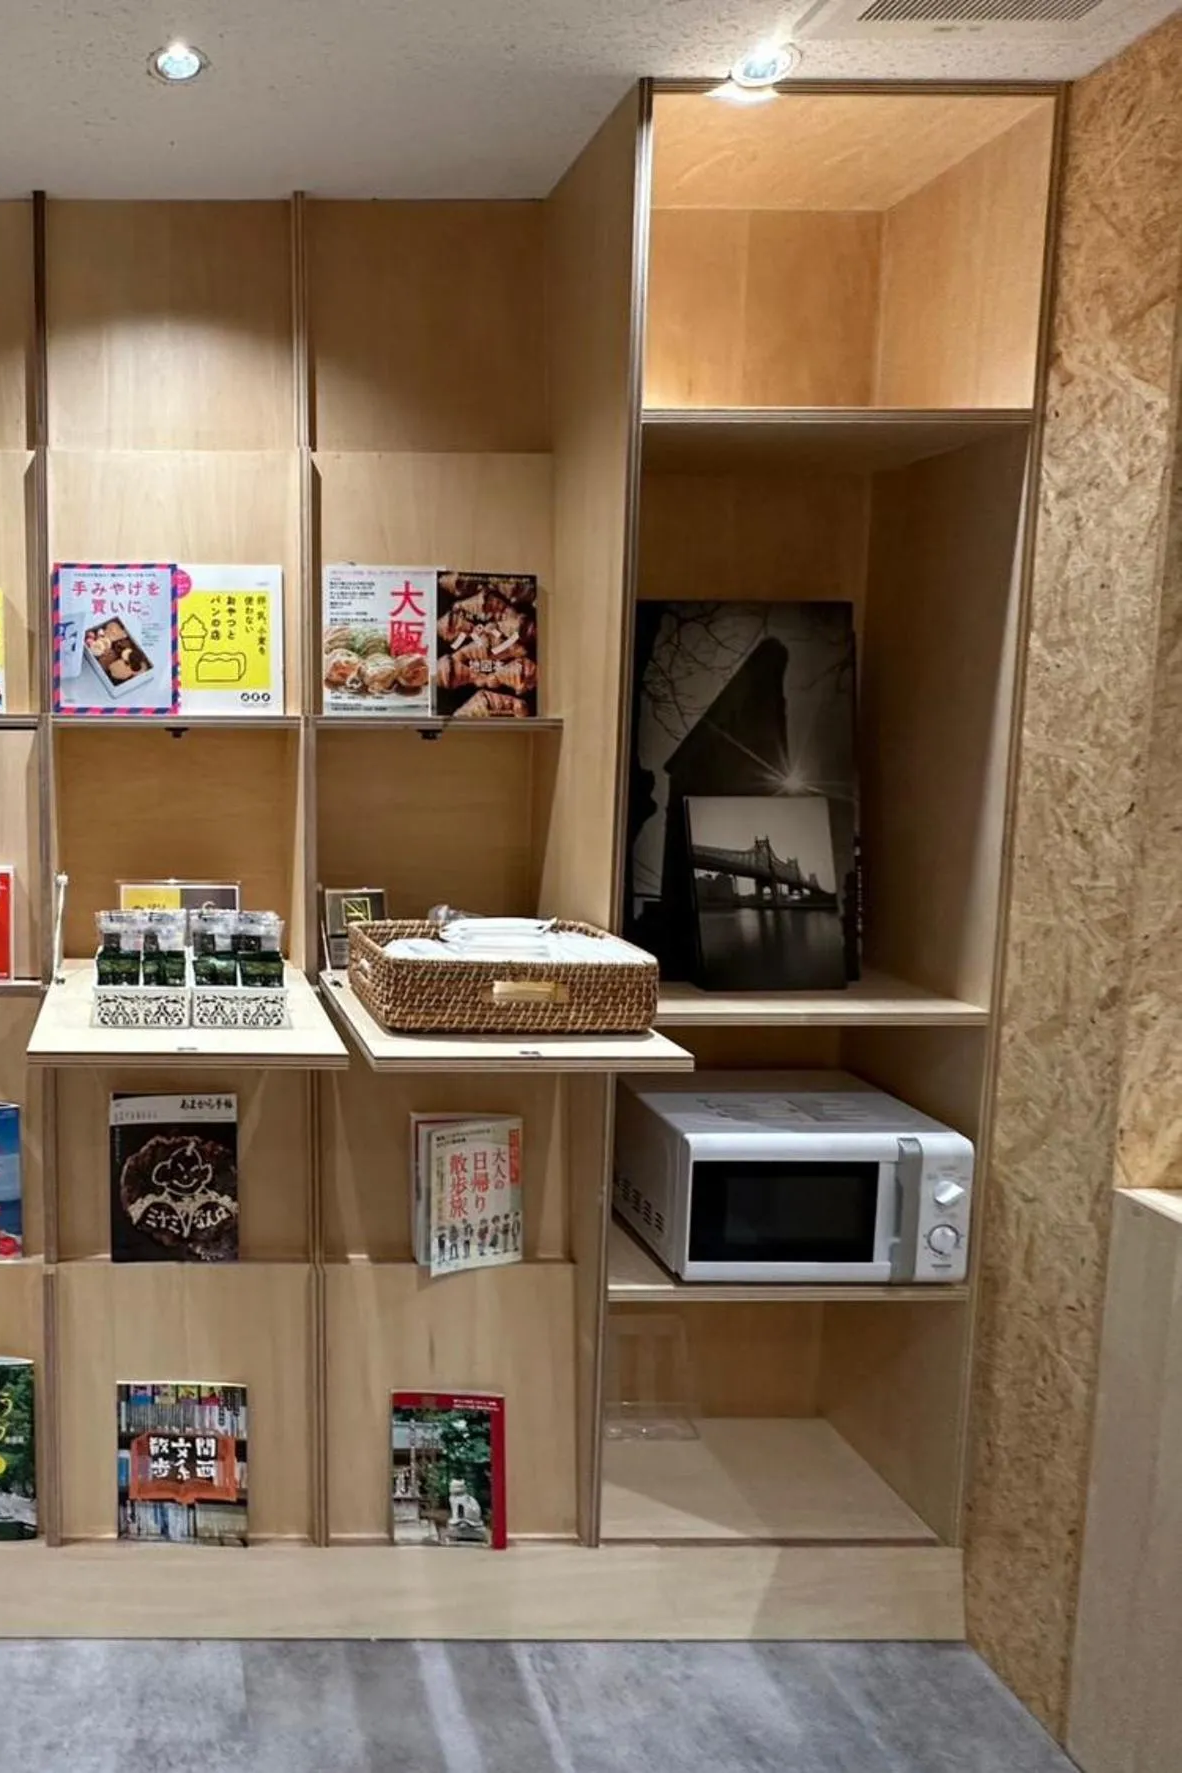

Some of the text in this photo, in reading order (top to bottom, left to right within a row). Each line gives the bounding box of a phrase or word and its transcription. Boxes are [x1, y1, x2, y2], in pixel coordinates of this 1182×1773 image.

[71, 580, 161, 597] 手みやげを
[389, 580, 429, 657] 大阪
[471, 1151, 490, 1213] 日帰り
[492, 1147, 507, 1190] 大人の
[148, 1437, 171, 1478] 散歩
[195, 1437, 216, 1478] 関西
